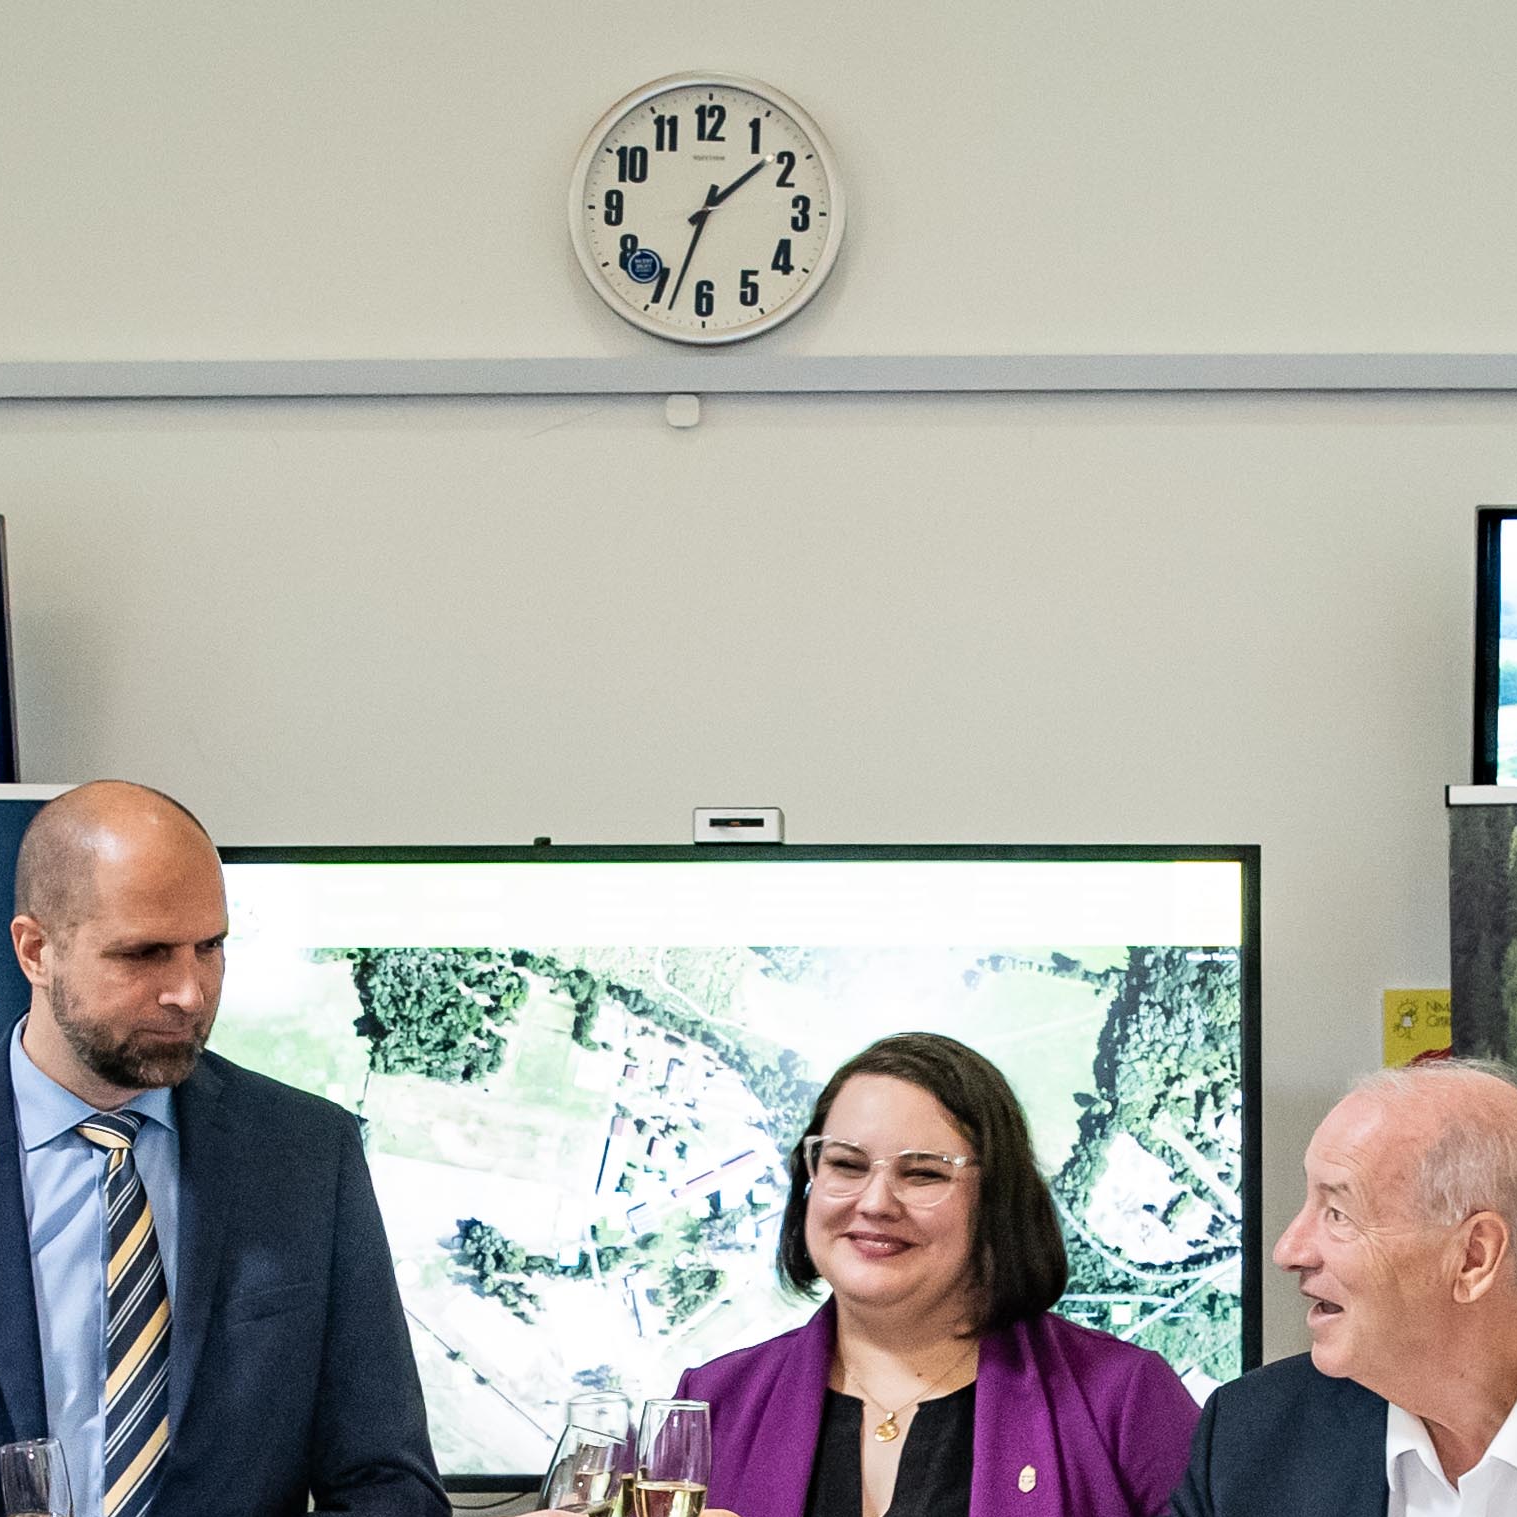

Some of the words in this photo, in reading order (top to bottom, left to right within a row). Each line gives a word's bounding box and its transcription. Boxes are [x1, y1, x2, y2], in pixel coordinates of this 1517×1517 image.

[653, 114, 679, 152] 11
[695, 104, 727, 142] 12
[748, 117, 761, 155] 1
[616, 145, 649, 184] 10
[776, 150, 796, 188] 2
[603, 189, 624, 227] 9
[790, 194, 811, 233] 3
[771, 238, 795, 276] 4
[694, 279, 715, 318] 6
[739, 269, 760, 307] 5
